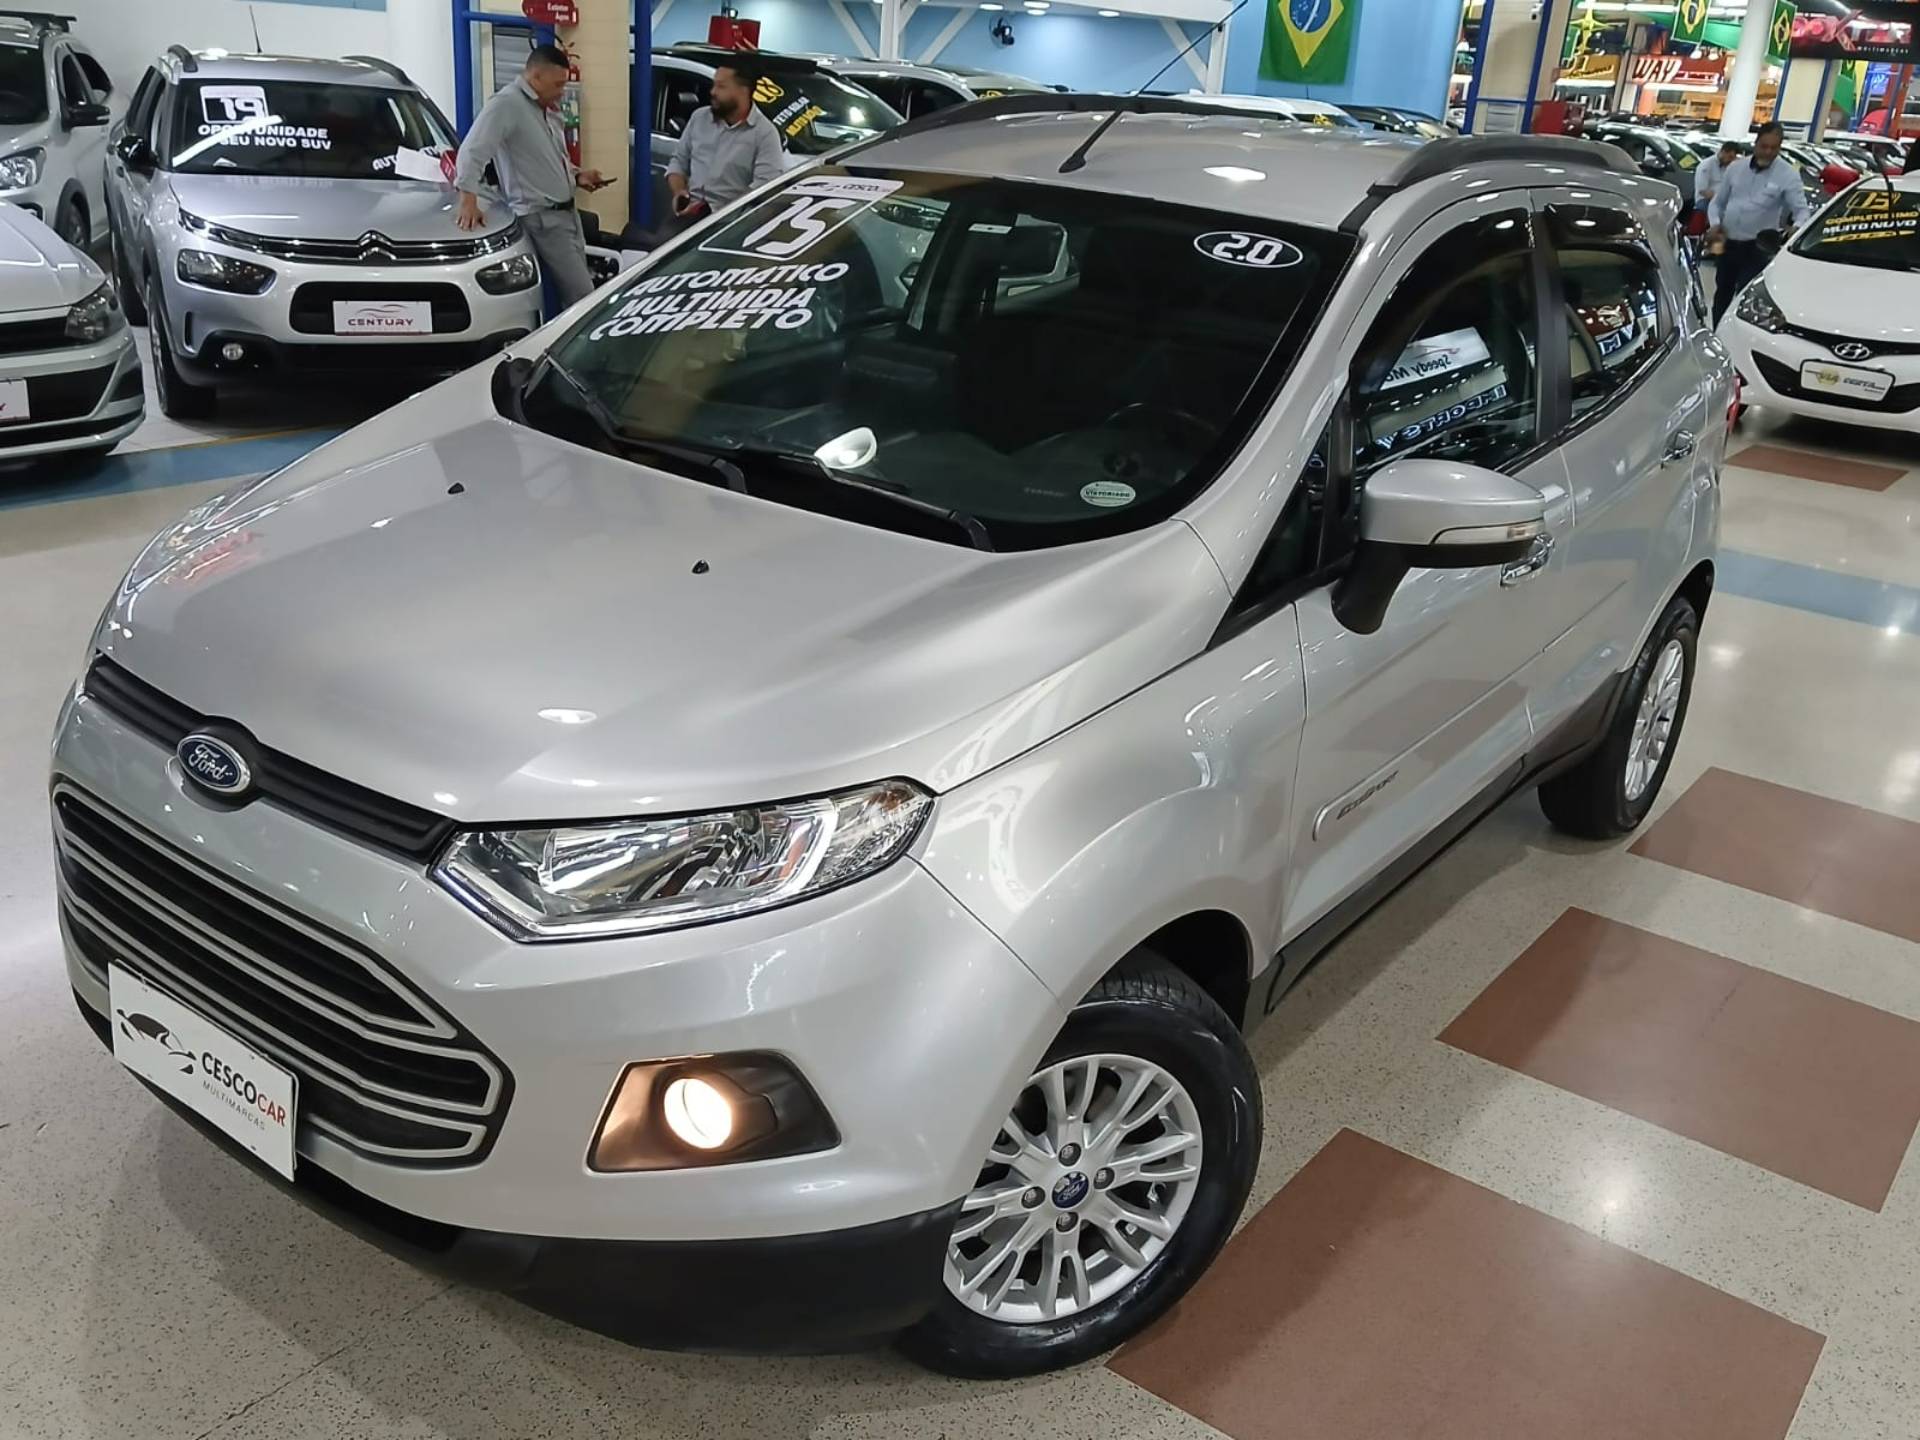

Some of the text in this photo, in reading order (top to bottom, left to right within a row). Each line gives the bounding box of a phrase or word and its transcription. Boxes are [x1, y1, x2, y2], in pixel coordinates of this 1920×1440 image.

[1632, 56, 1681, 83] WAY
[220, 98, 265, 121] 19
[198, 124, 328, 139] OPOUNIDADE
[254, 136, 297, 147] NOVO
[301, 139, 331, 150] SUV
[743, 196, 857, 254] 15
[1822, 223, 1869, 235] MUITO
[1212, 233, 1283, 265] 2.0
[347, 318, 414, 326] CENTURY
[589, 308, 813, 341] COMPLETO
[188, 743, 230, 780] Ford
[201, 1051, 287, 1128] CESCOCAR
[202, 1080, 266, 1131] MULTIMARCAS
